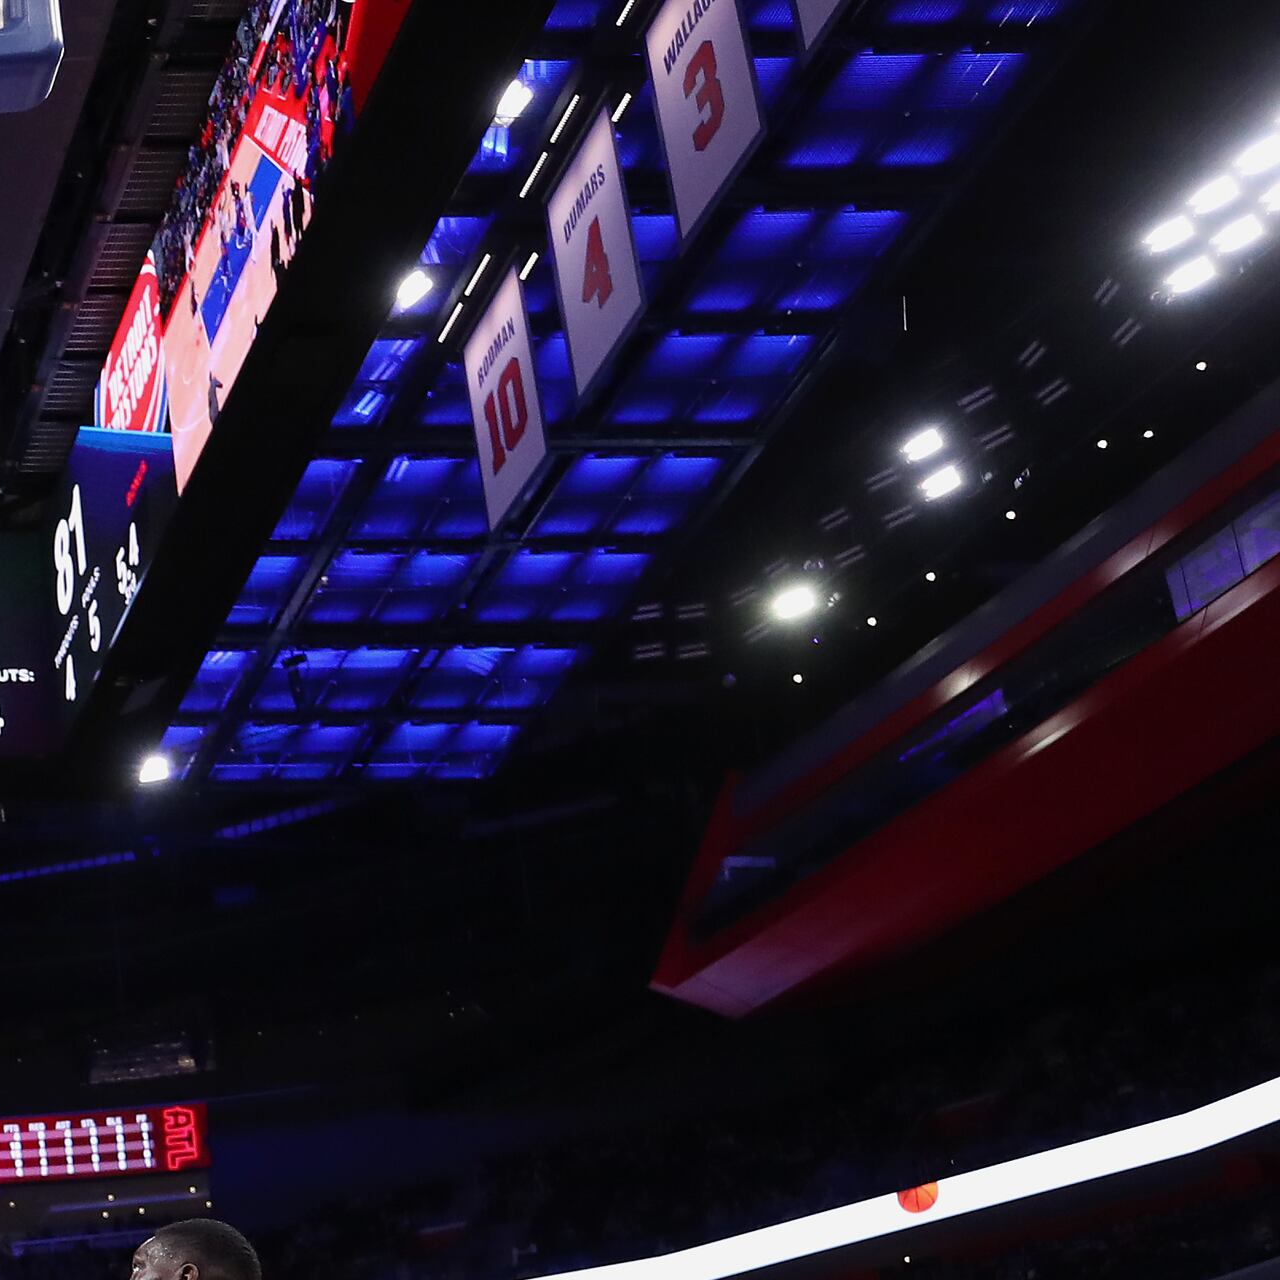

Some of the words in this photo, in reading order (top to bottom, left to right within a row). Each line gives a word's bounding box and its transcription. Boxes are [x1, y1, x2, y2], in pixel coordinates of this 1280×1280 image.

[683, 40, 725, 151] 3
[563, 163, 606, 244] DUMARS
[582, 214, 613, 309] 4
[477, 317, 516, 387] RODMAN
[484, 357, 528, 475] 10
[54, 483, 87, 615] 81
[88, 599, 101, 652] 5
[164, 1106, 199, 1171] ATL
